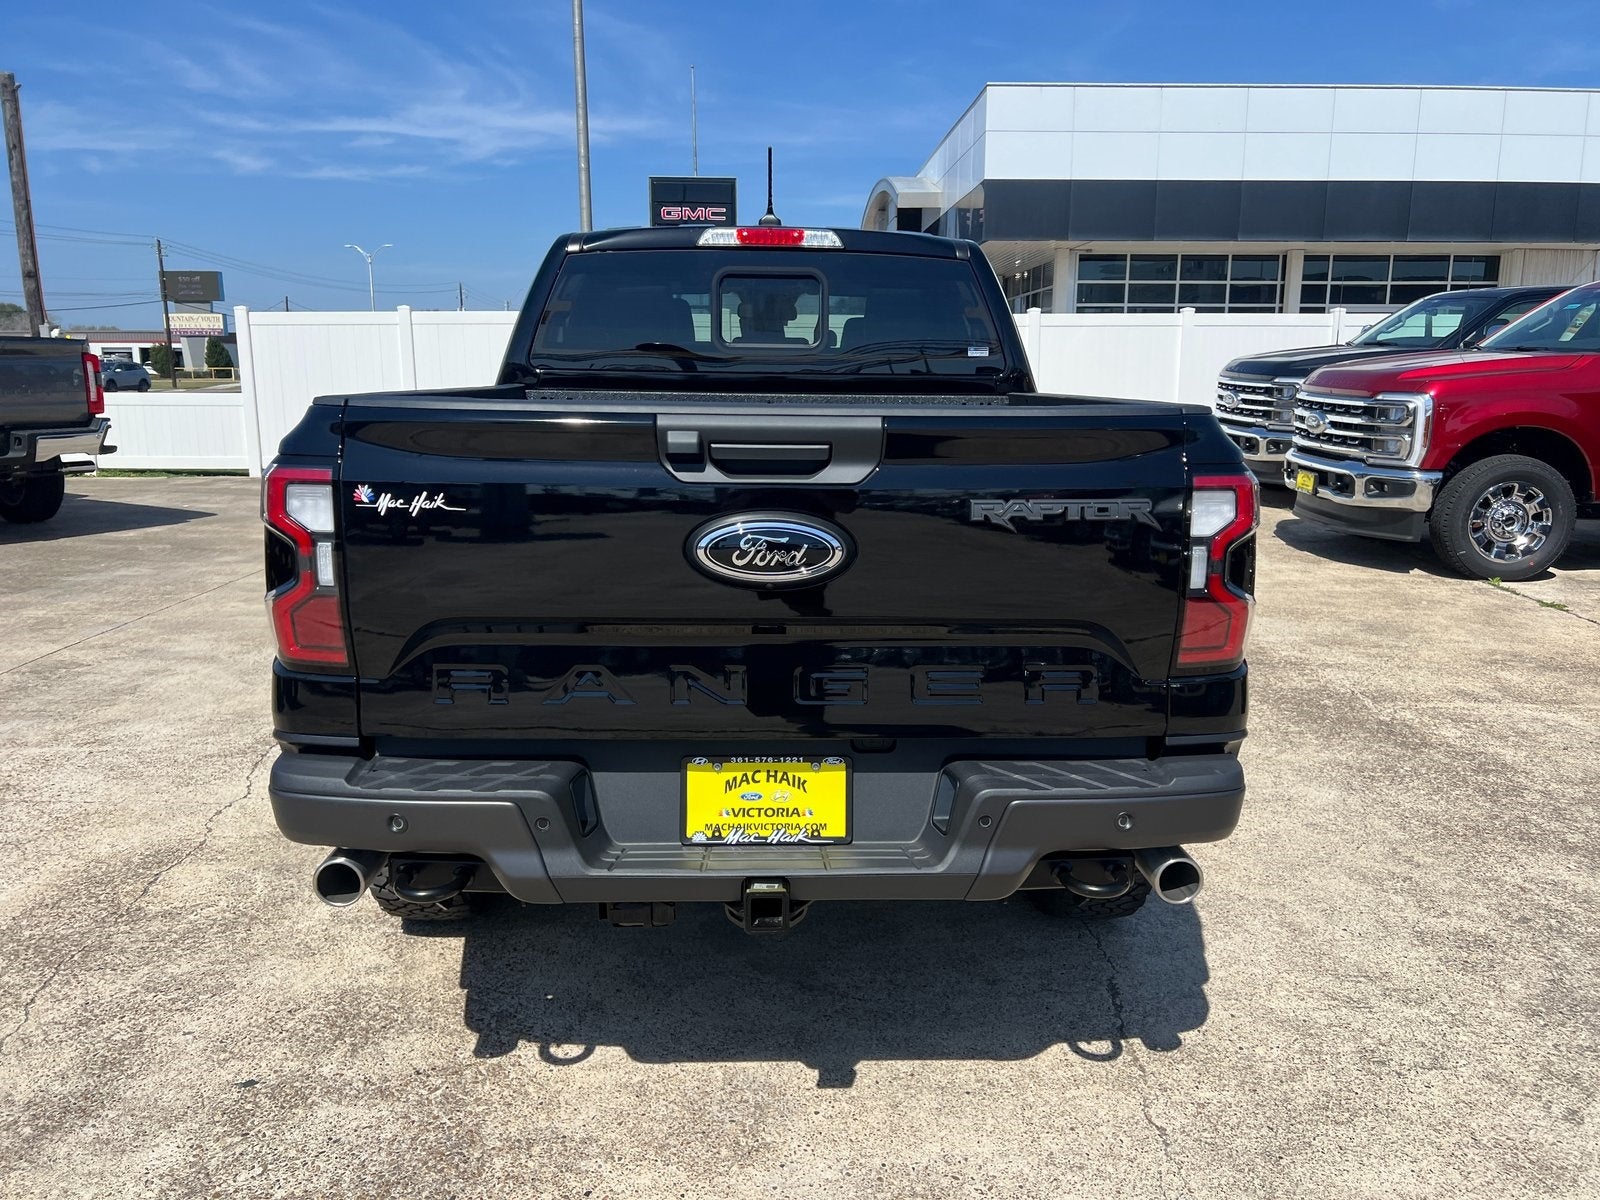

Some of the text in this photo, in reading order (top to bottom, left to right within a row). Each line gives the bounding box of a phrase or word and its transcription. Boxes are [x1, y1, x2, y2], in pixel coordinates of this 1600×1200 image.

[661, 207, 726, 221] GMC
[200, 315, 221, 324] YOUTH
[370, 491, 459, 517] Mac Haik
[970, 498, 1164, 534] RAPTOR
[732, 534, 808, 567] Ford
[432, 664, 1098, 706] RANGER
[730, 756, 804, 764] 361-576-1221
[724, 769, 808, 794] MAC HAIK
[731, 807, 801, 818] VICTORIA
[704, 822, 827, 831] MACHAIKVICTORIA.COM
[720, 827, 824, 844] Mac Haik
